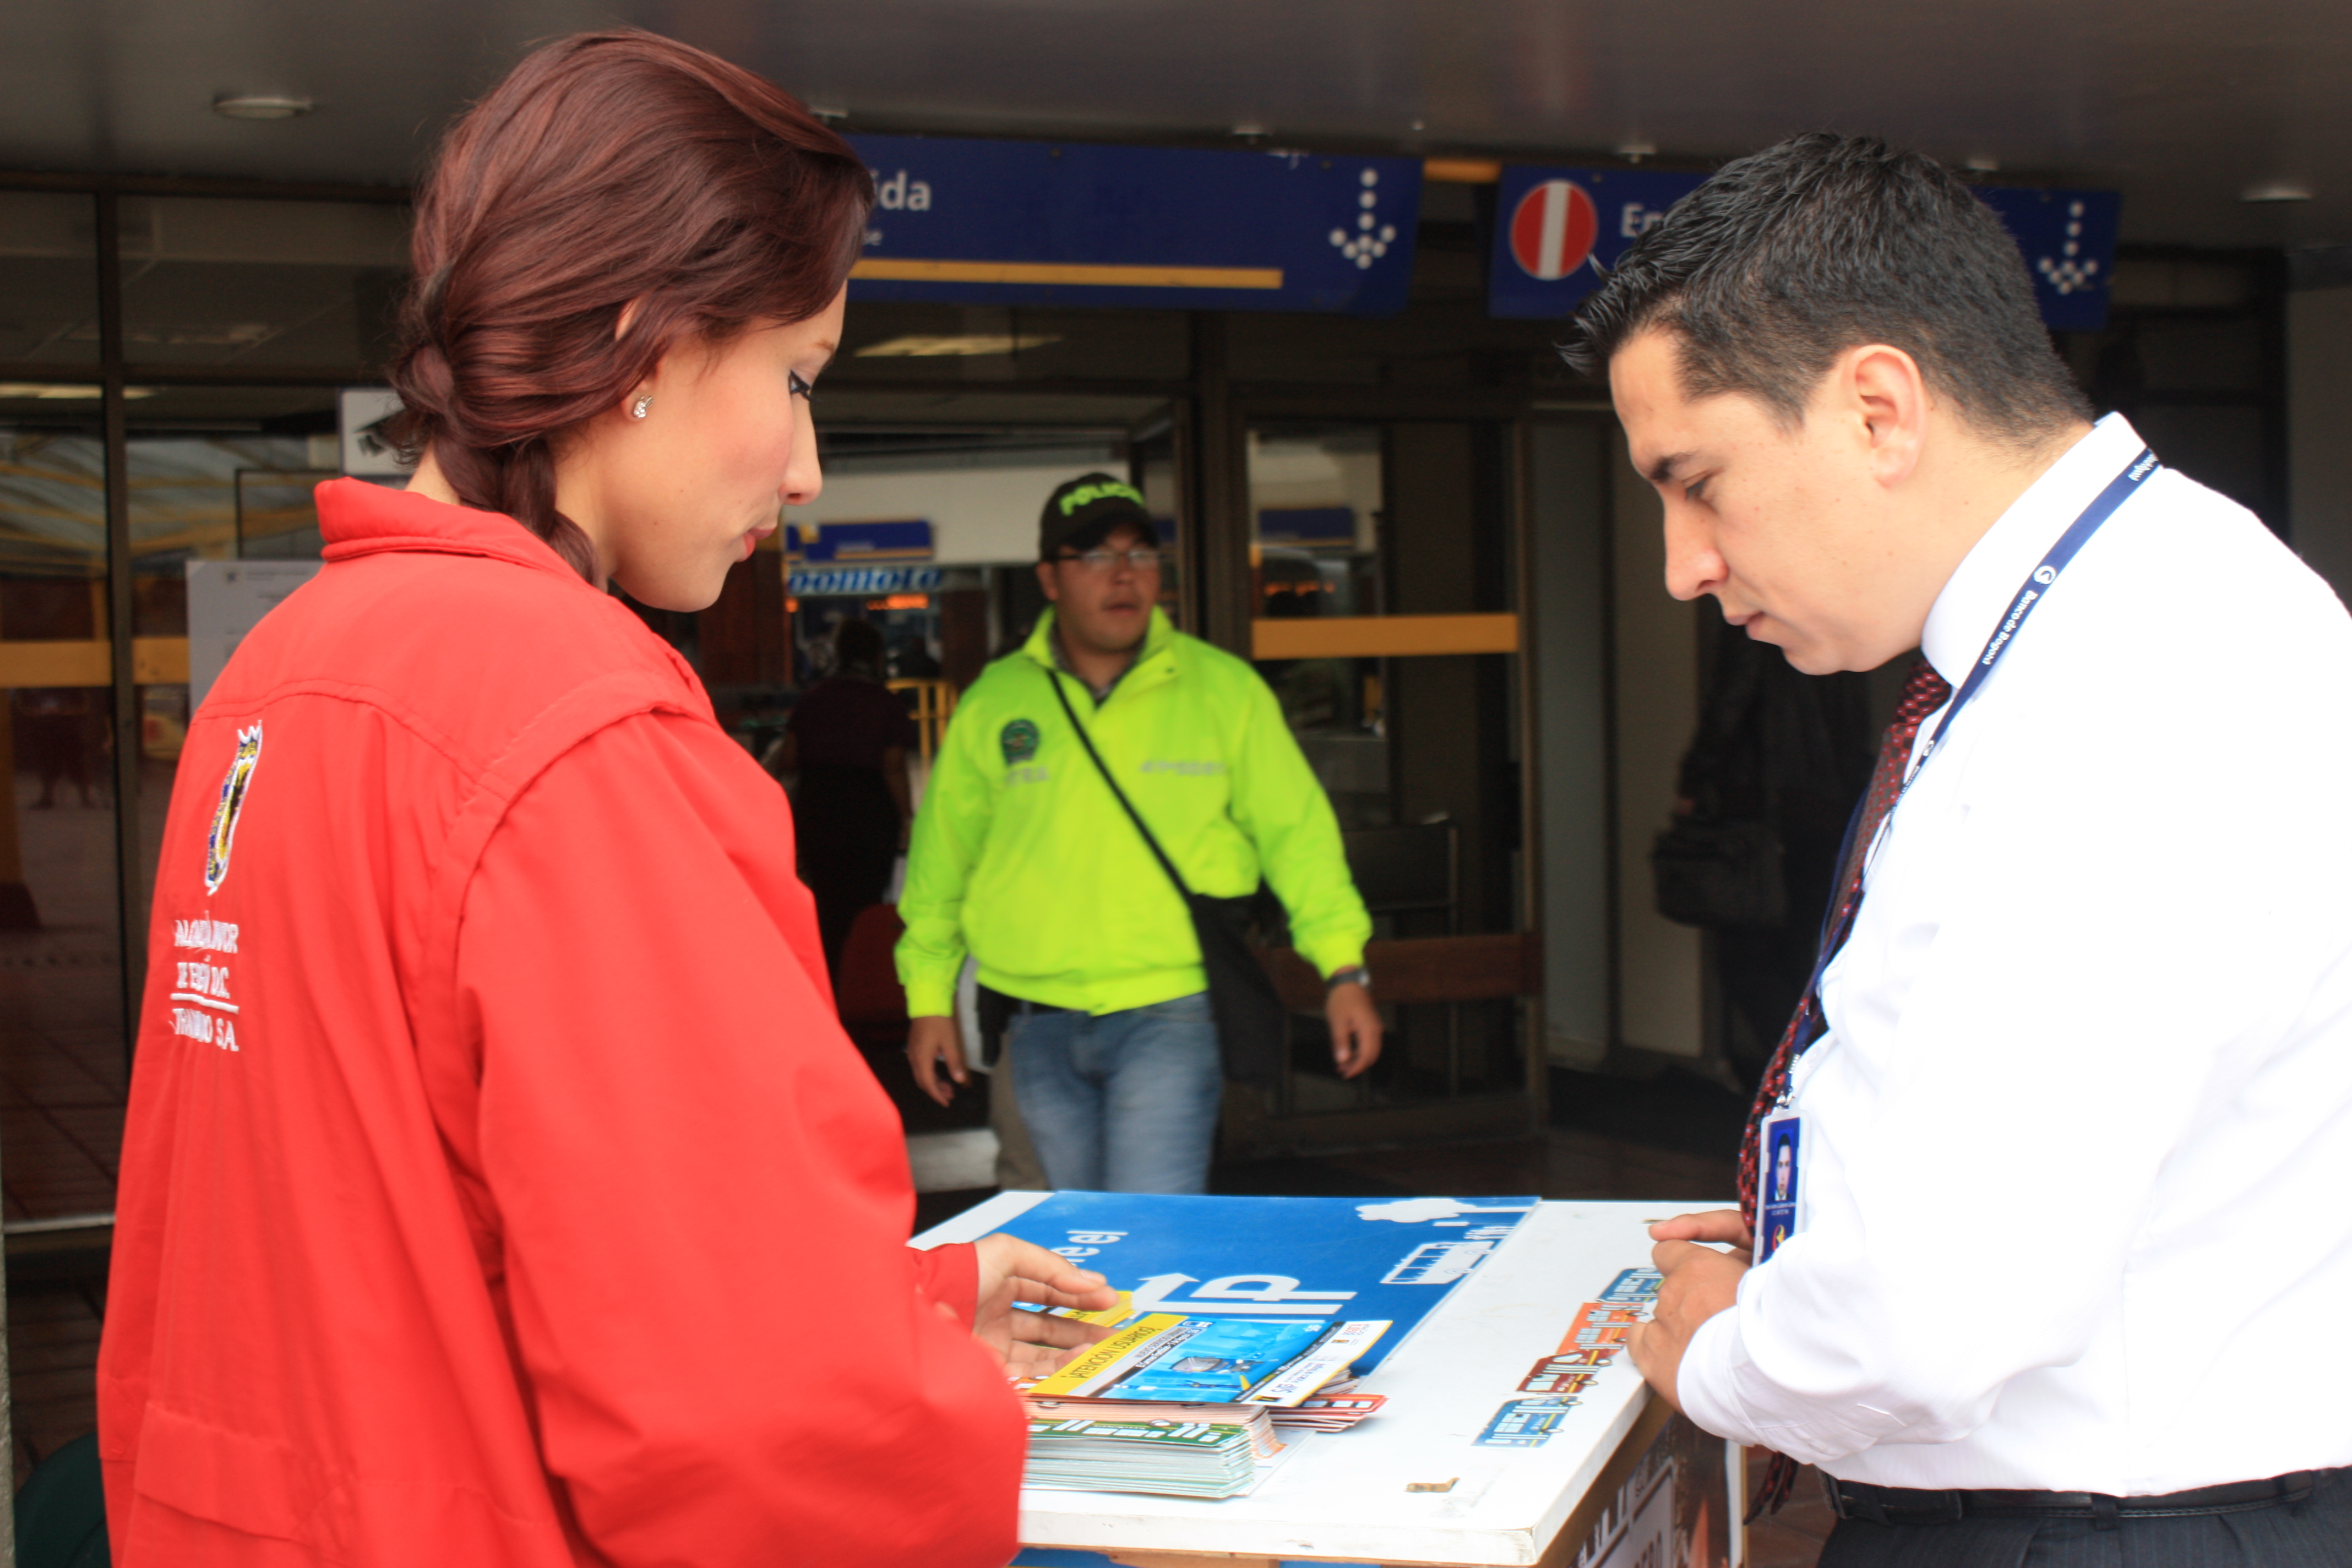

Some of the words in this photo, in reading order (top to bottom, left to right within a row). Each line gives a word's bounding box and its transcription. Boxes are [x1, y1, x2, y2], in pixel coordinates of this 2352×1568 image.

[1066, 1230, 1129, 1244] el
[1060, 1348, 1121, 1379] ¡ATENCIÓN
[1107, 1326, 1163, 1350] USUARIOS!
